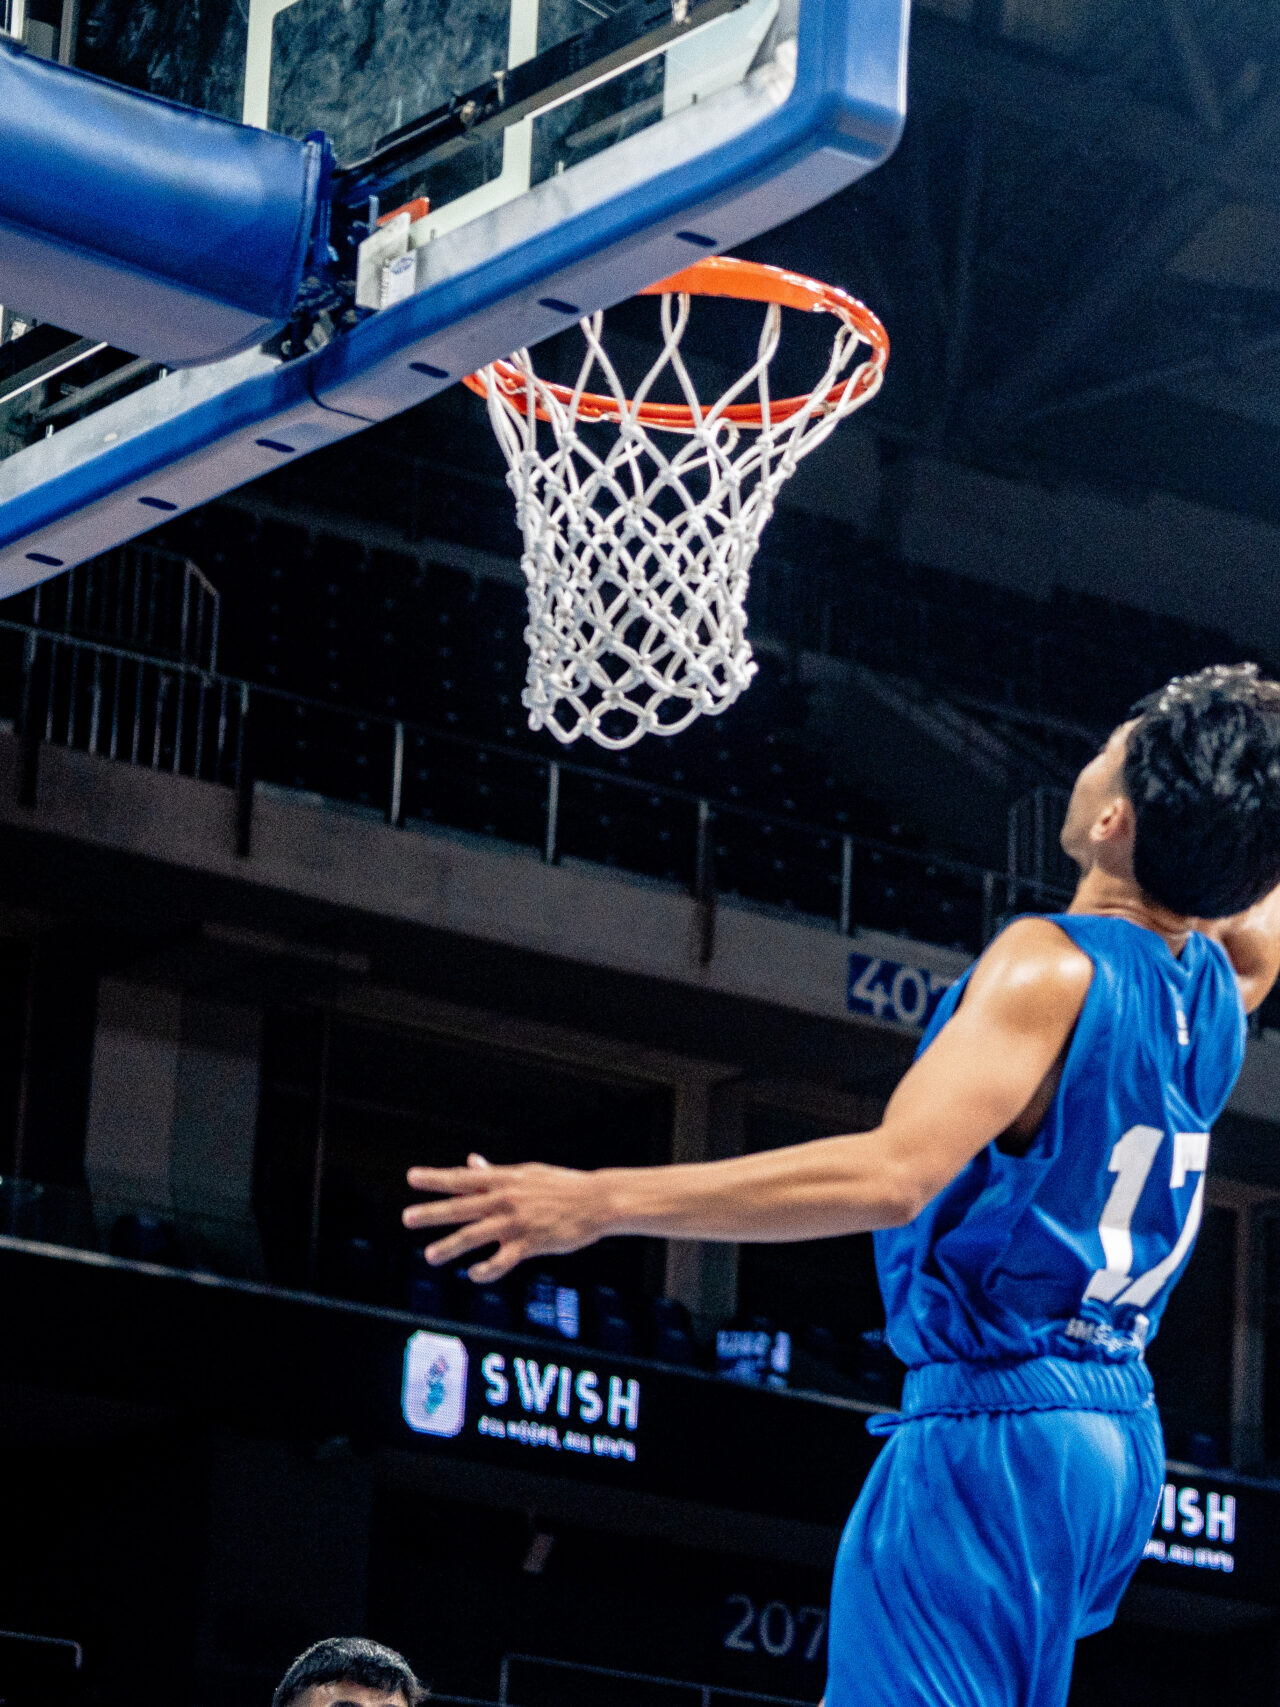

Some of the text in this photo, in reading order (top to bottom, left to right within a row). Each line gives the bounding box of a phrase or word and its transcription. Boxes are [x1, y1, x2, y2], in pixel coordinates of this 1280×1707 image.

[1082, 1124, 1210, 1308] 17
[481, 1352, 640, 1431] SWISH
[1152, 1483, 1237, 1544] ISH
[722, 1592, 828, 1661] 207
